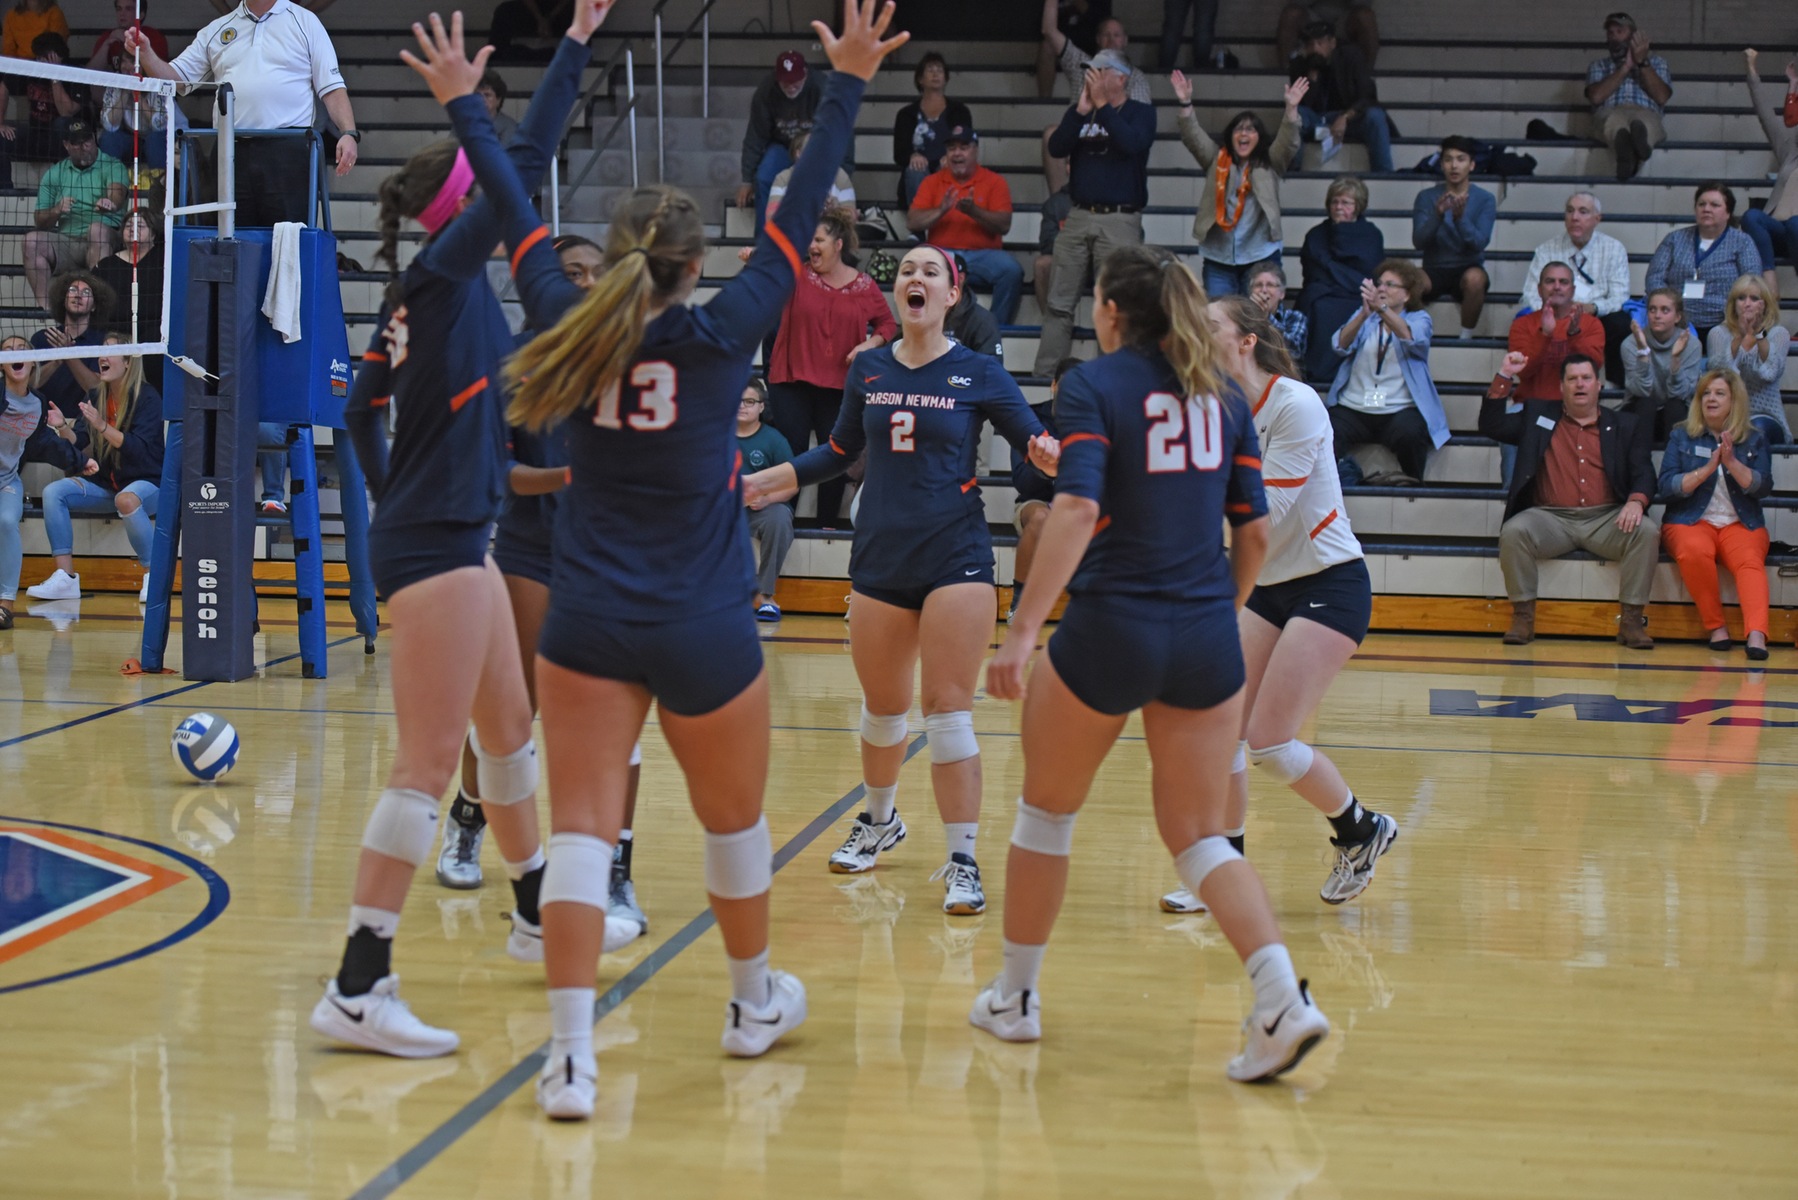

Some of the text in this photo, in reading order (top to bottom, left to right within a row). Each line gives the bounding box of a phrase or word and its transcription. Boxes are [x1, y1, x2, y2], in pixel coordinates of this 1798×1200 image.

[592, 359, 679, 432] 13
[865, 391, 956, 410] CARSON NEWMAN
[950, 375, 973, 387] SAC
[889, 409, 916, 452] 2
[1143, 391, 1224, 474] 20
